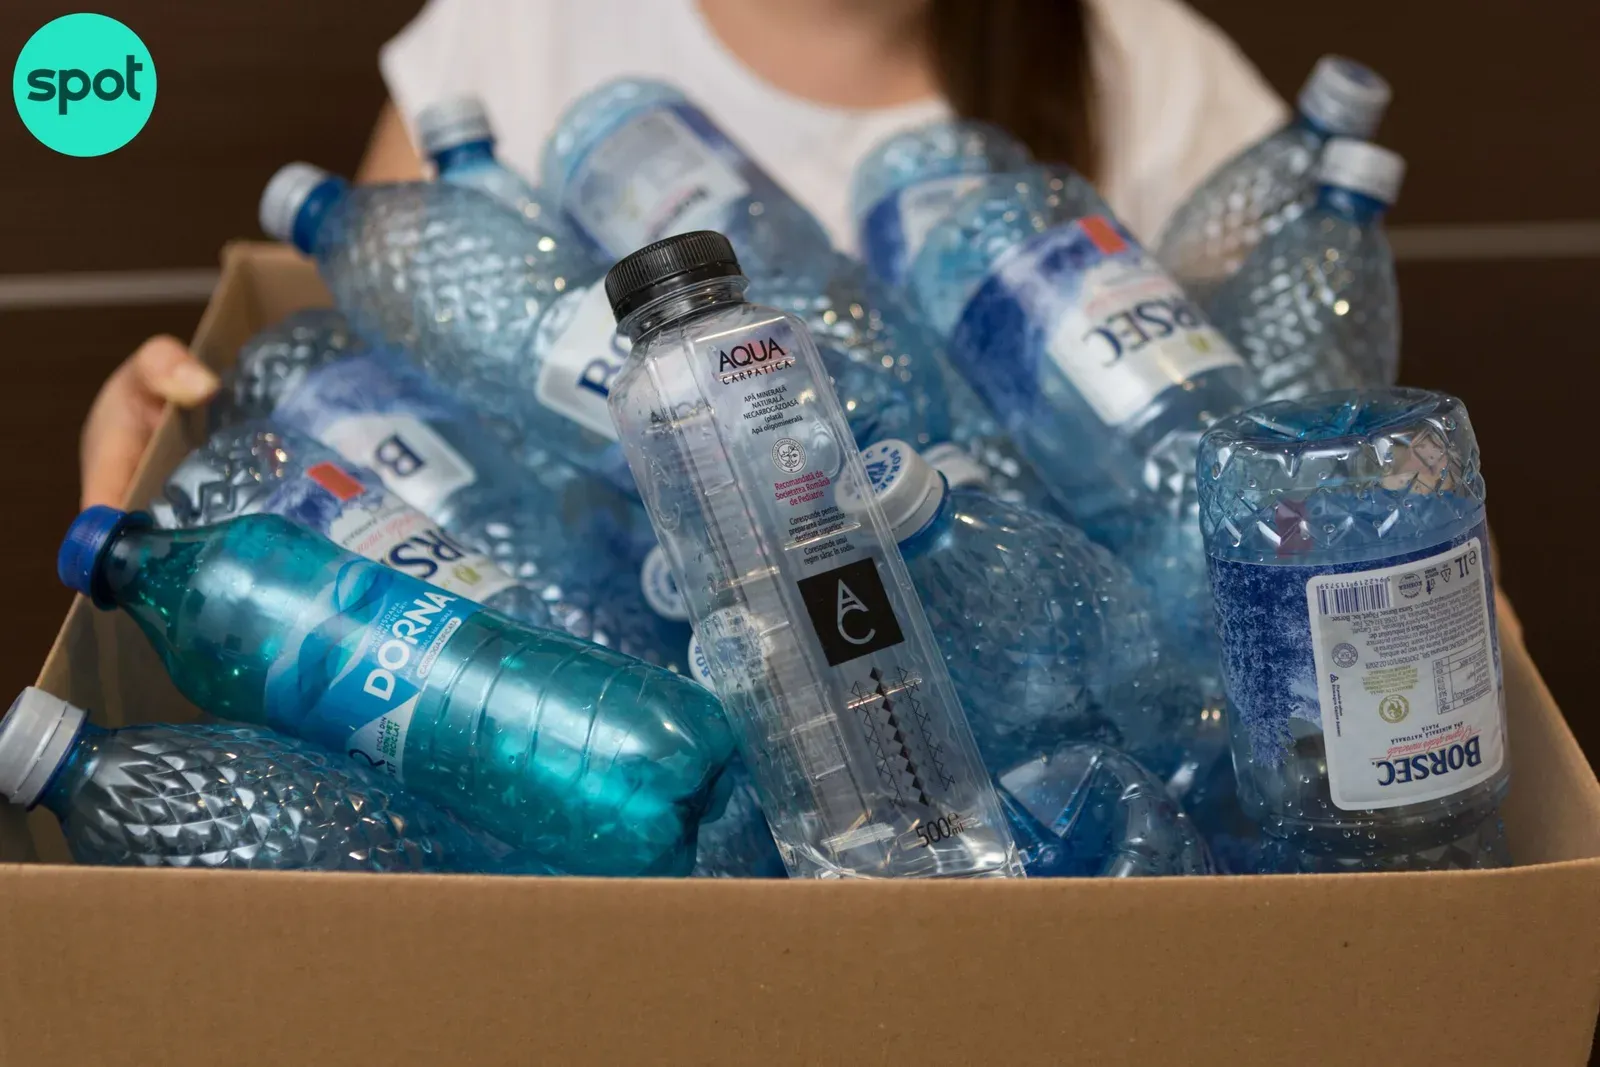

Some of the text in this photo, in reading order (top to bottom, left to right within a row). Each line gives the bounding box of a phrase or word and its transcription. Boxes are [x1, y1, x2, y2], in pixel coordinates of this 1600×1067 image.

[720, 337, 786, 372] AQUA
[722, 360, 792, 385] CARPATICA
[813, 470, 824, 479] de
[789, 498, 799, 506] de
[363, 591, 458, 701] DORNA
[1375, 735, 1482, 787] BORSEC
[915, 821, 950, 849] 500
